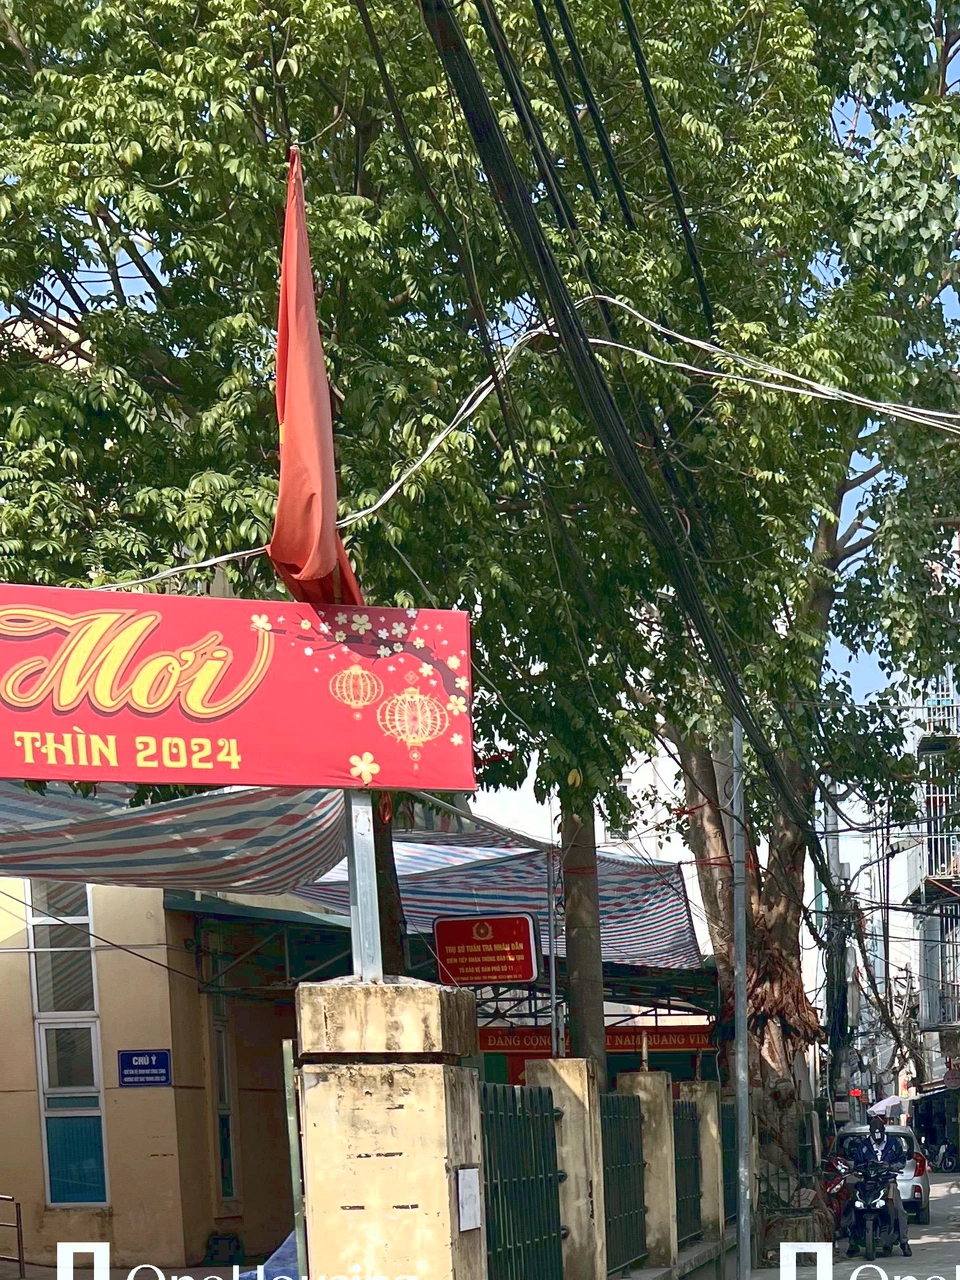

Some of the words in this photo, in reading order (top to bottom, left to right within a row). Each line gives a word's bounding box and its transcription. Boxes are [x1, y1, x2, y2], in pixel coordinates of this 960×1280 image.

[0, 604, 273, 722] Mới
[14, 725, 119, 767] THÌN
[135, 736, 242, 769] 2024
[482, 944, 493, 952] TRA
[488, 1031, 520, 1046] ĐẢNG
